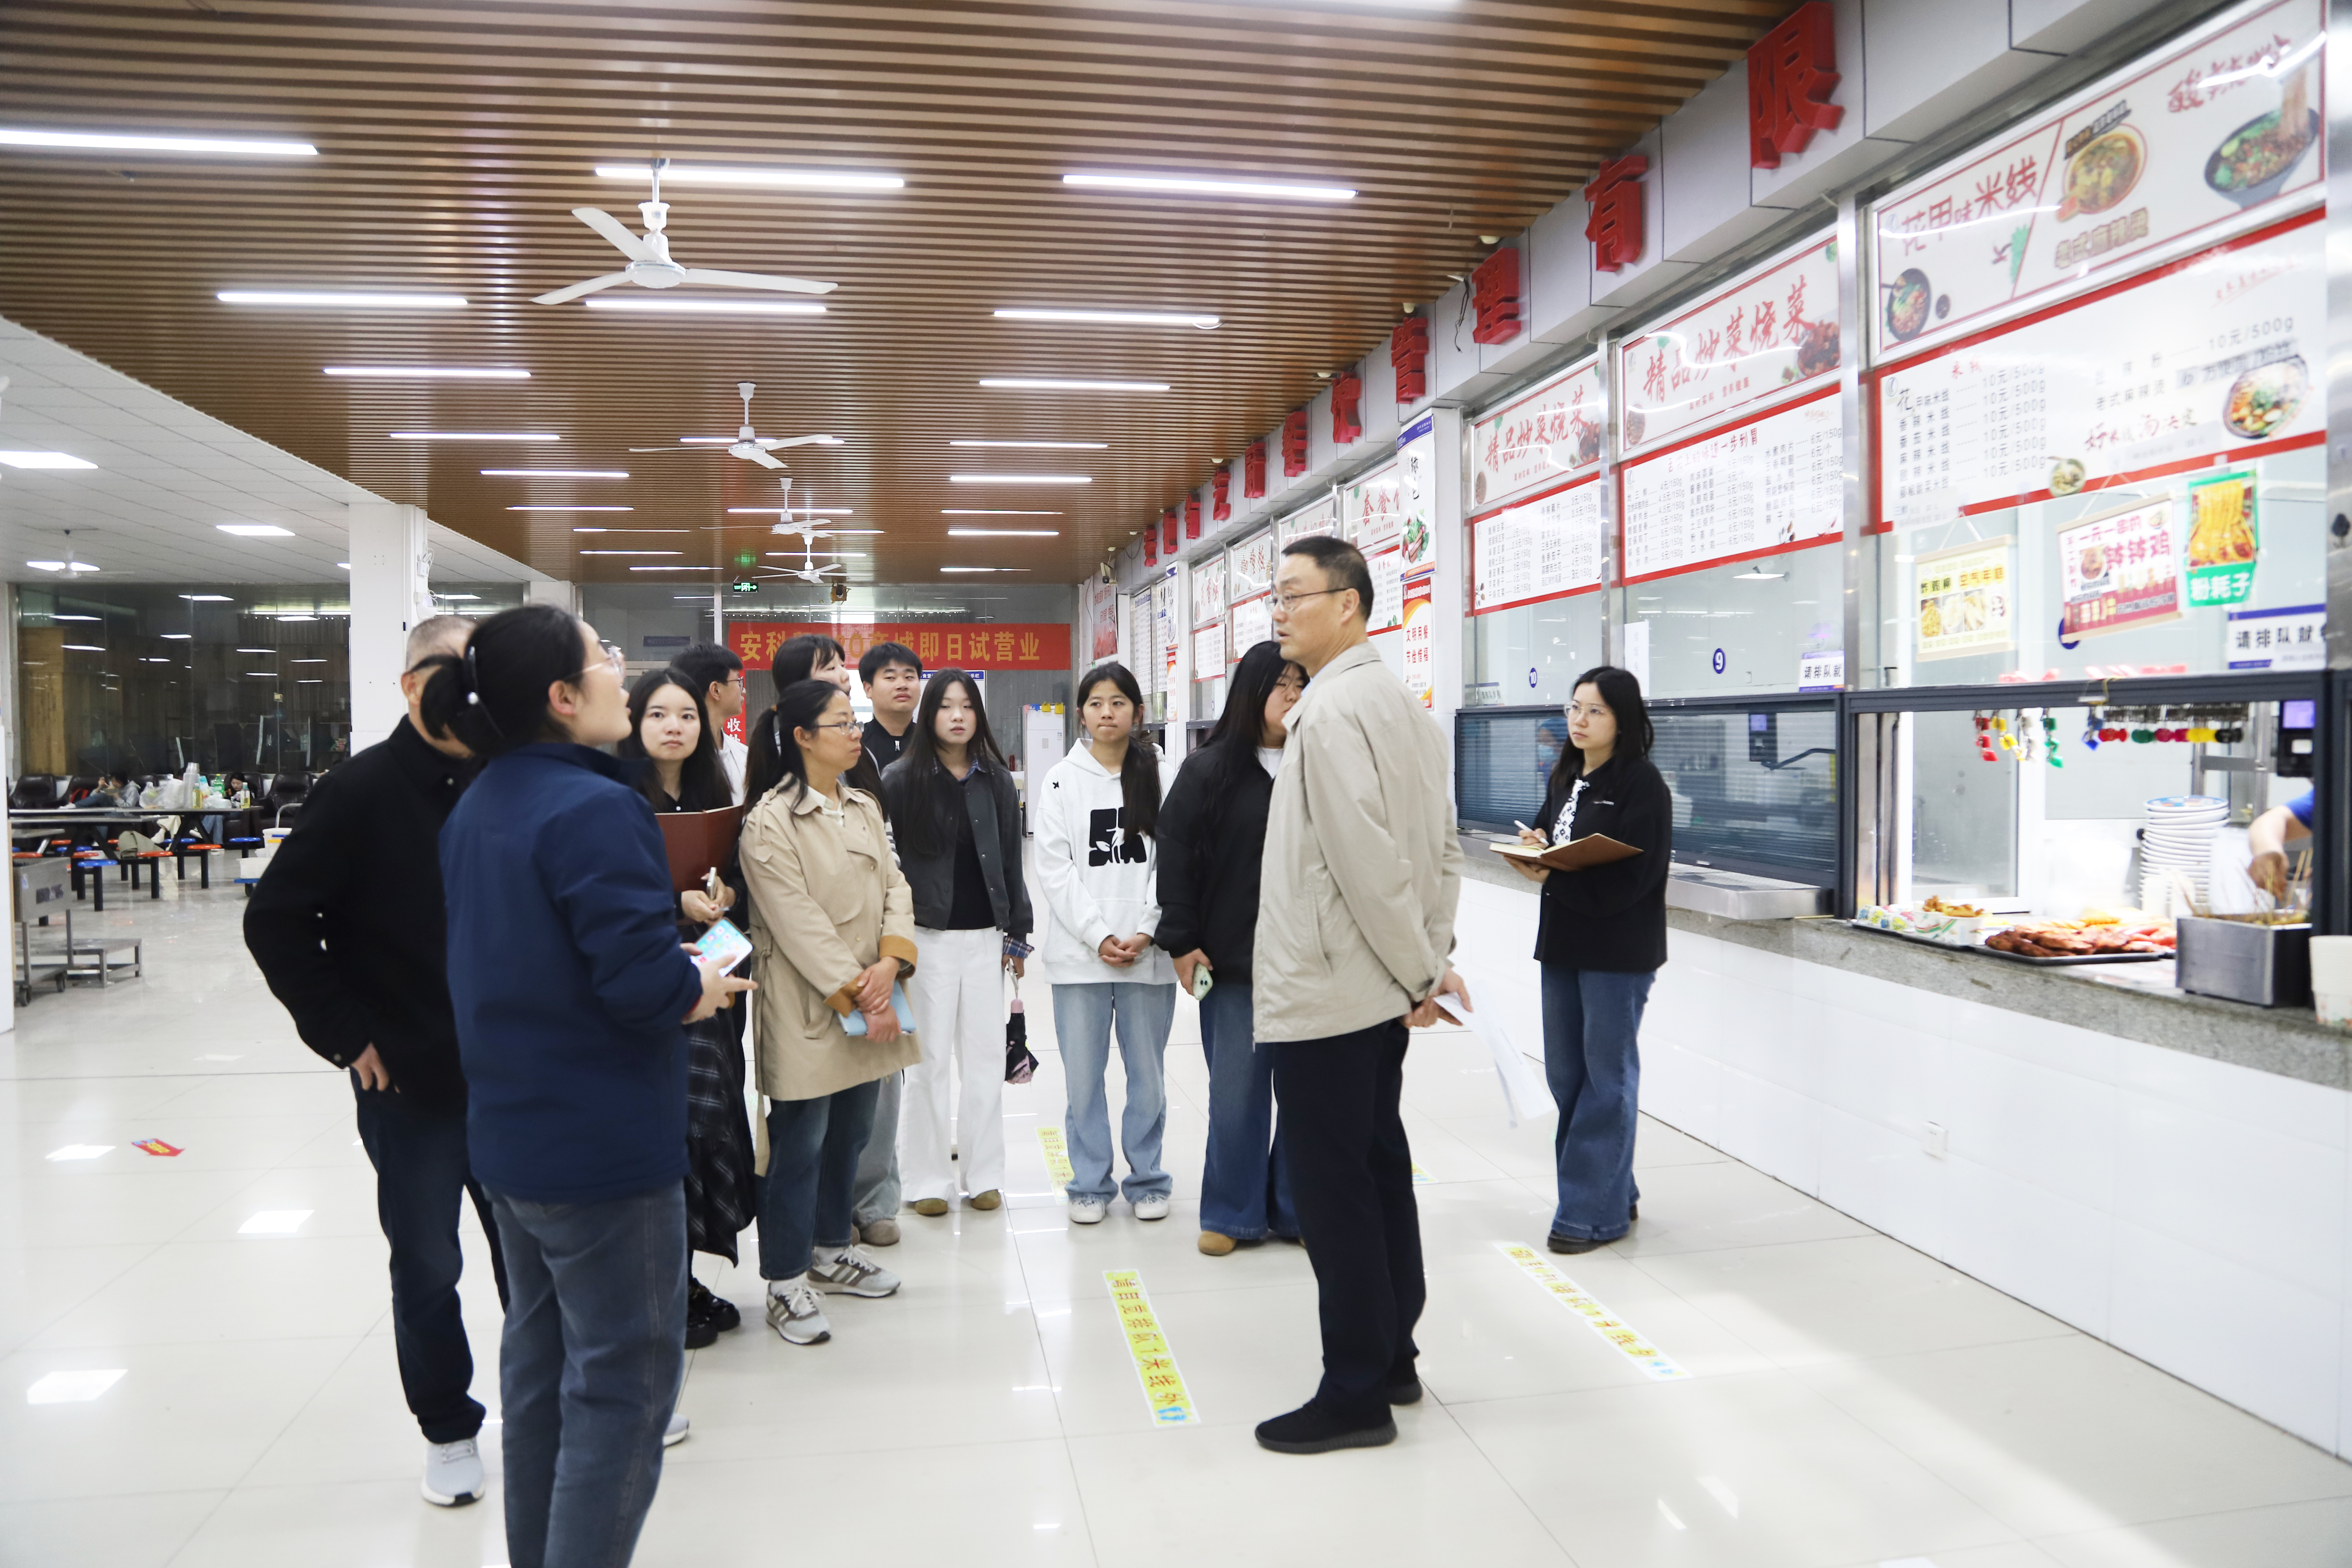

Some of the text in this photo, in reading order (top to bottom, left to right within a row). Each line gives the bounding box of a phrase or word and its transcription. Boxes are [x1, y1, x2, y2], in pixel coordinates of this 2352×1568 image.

[1902, 155, 2037, 256] 花甲味米线
[1643, 274, 1816, 403] 精品炒菜烧菜
[1485, 384, 1588, 473] 精品炒菜烧菜
[1407, 625, 1428, 642] 文明用餐
[1715, 652, 1724, 671] 9
[1530, 671, 1537, 684] 10
[1804, 664, 1842, 679] 请排队就
